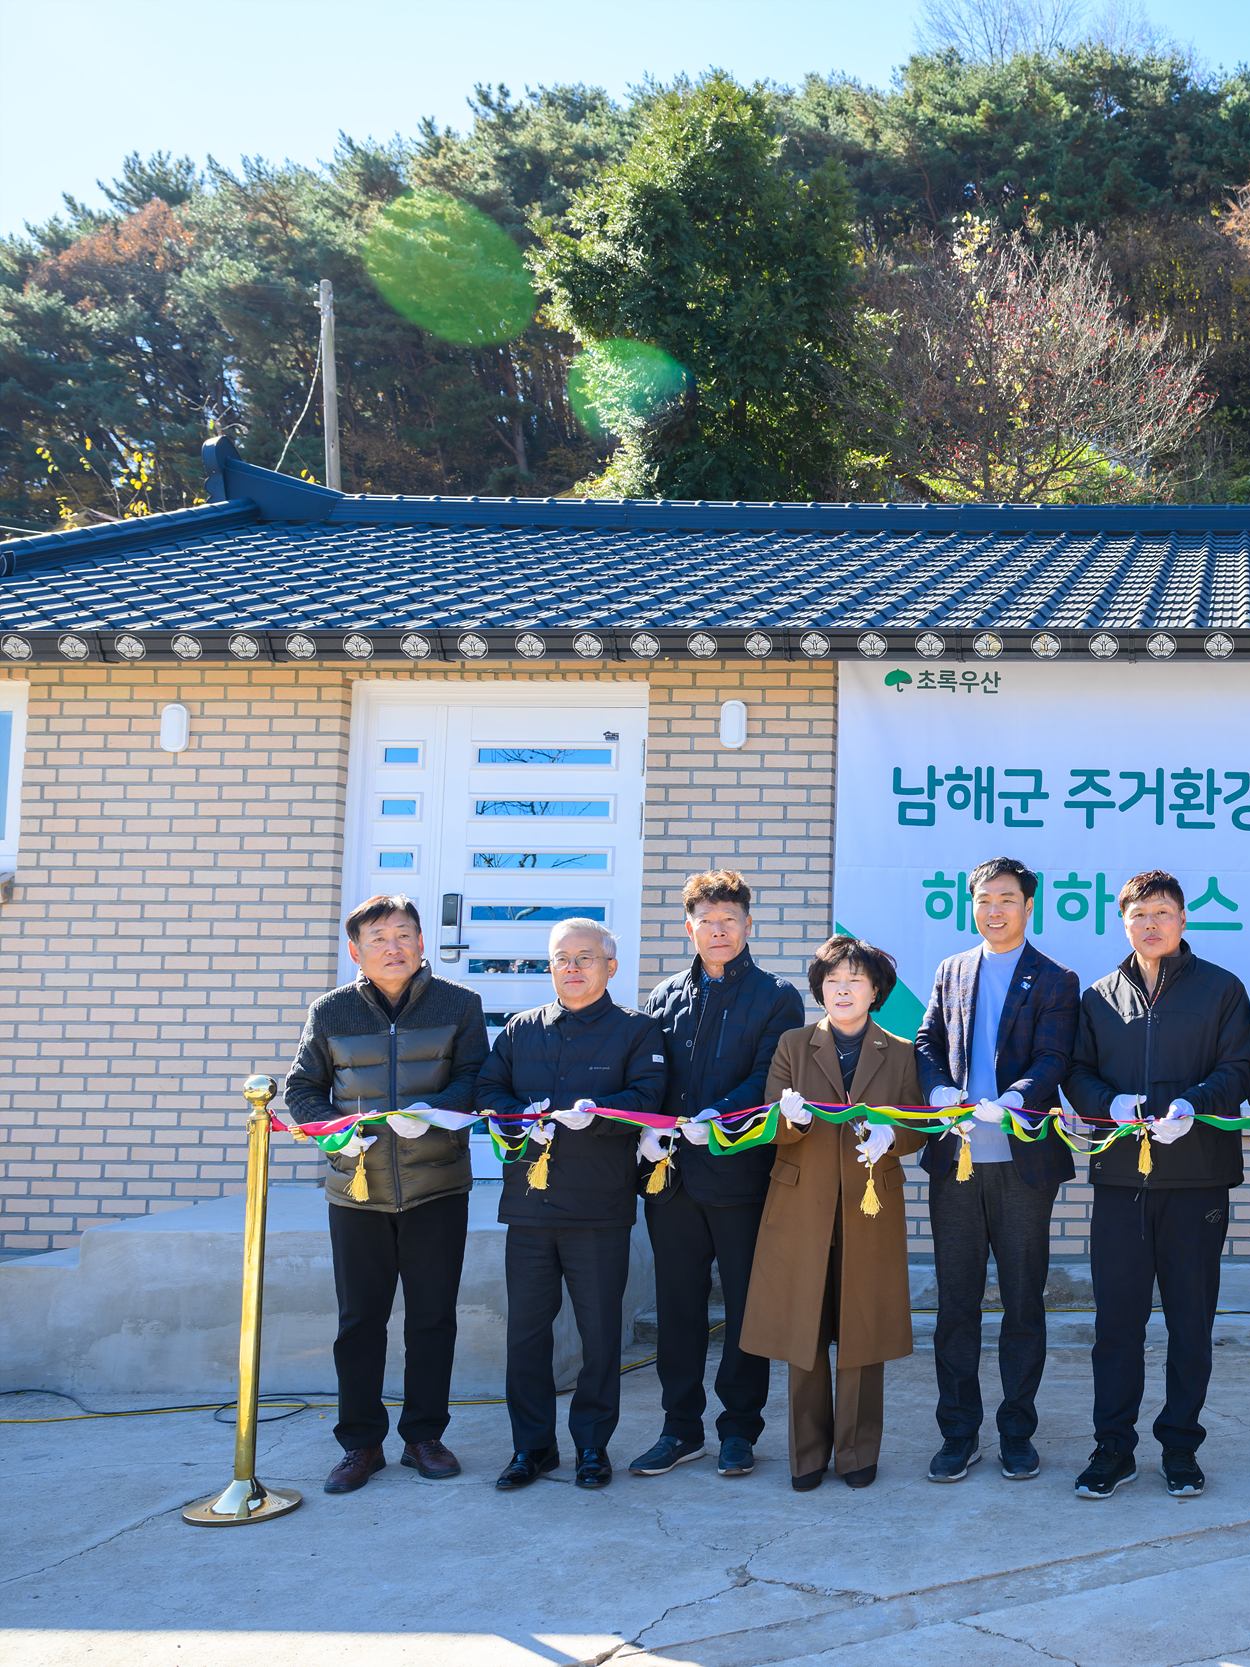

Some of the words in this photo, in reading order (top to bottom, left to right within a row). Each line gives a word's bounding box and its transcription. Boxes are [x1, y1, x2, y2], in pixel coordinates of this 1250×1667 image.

[916, 669, 1002, 694] 초록우산
[892, 764, 1050, 828] 남해군
[921, 870, 1243, 936] 해하스
